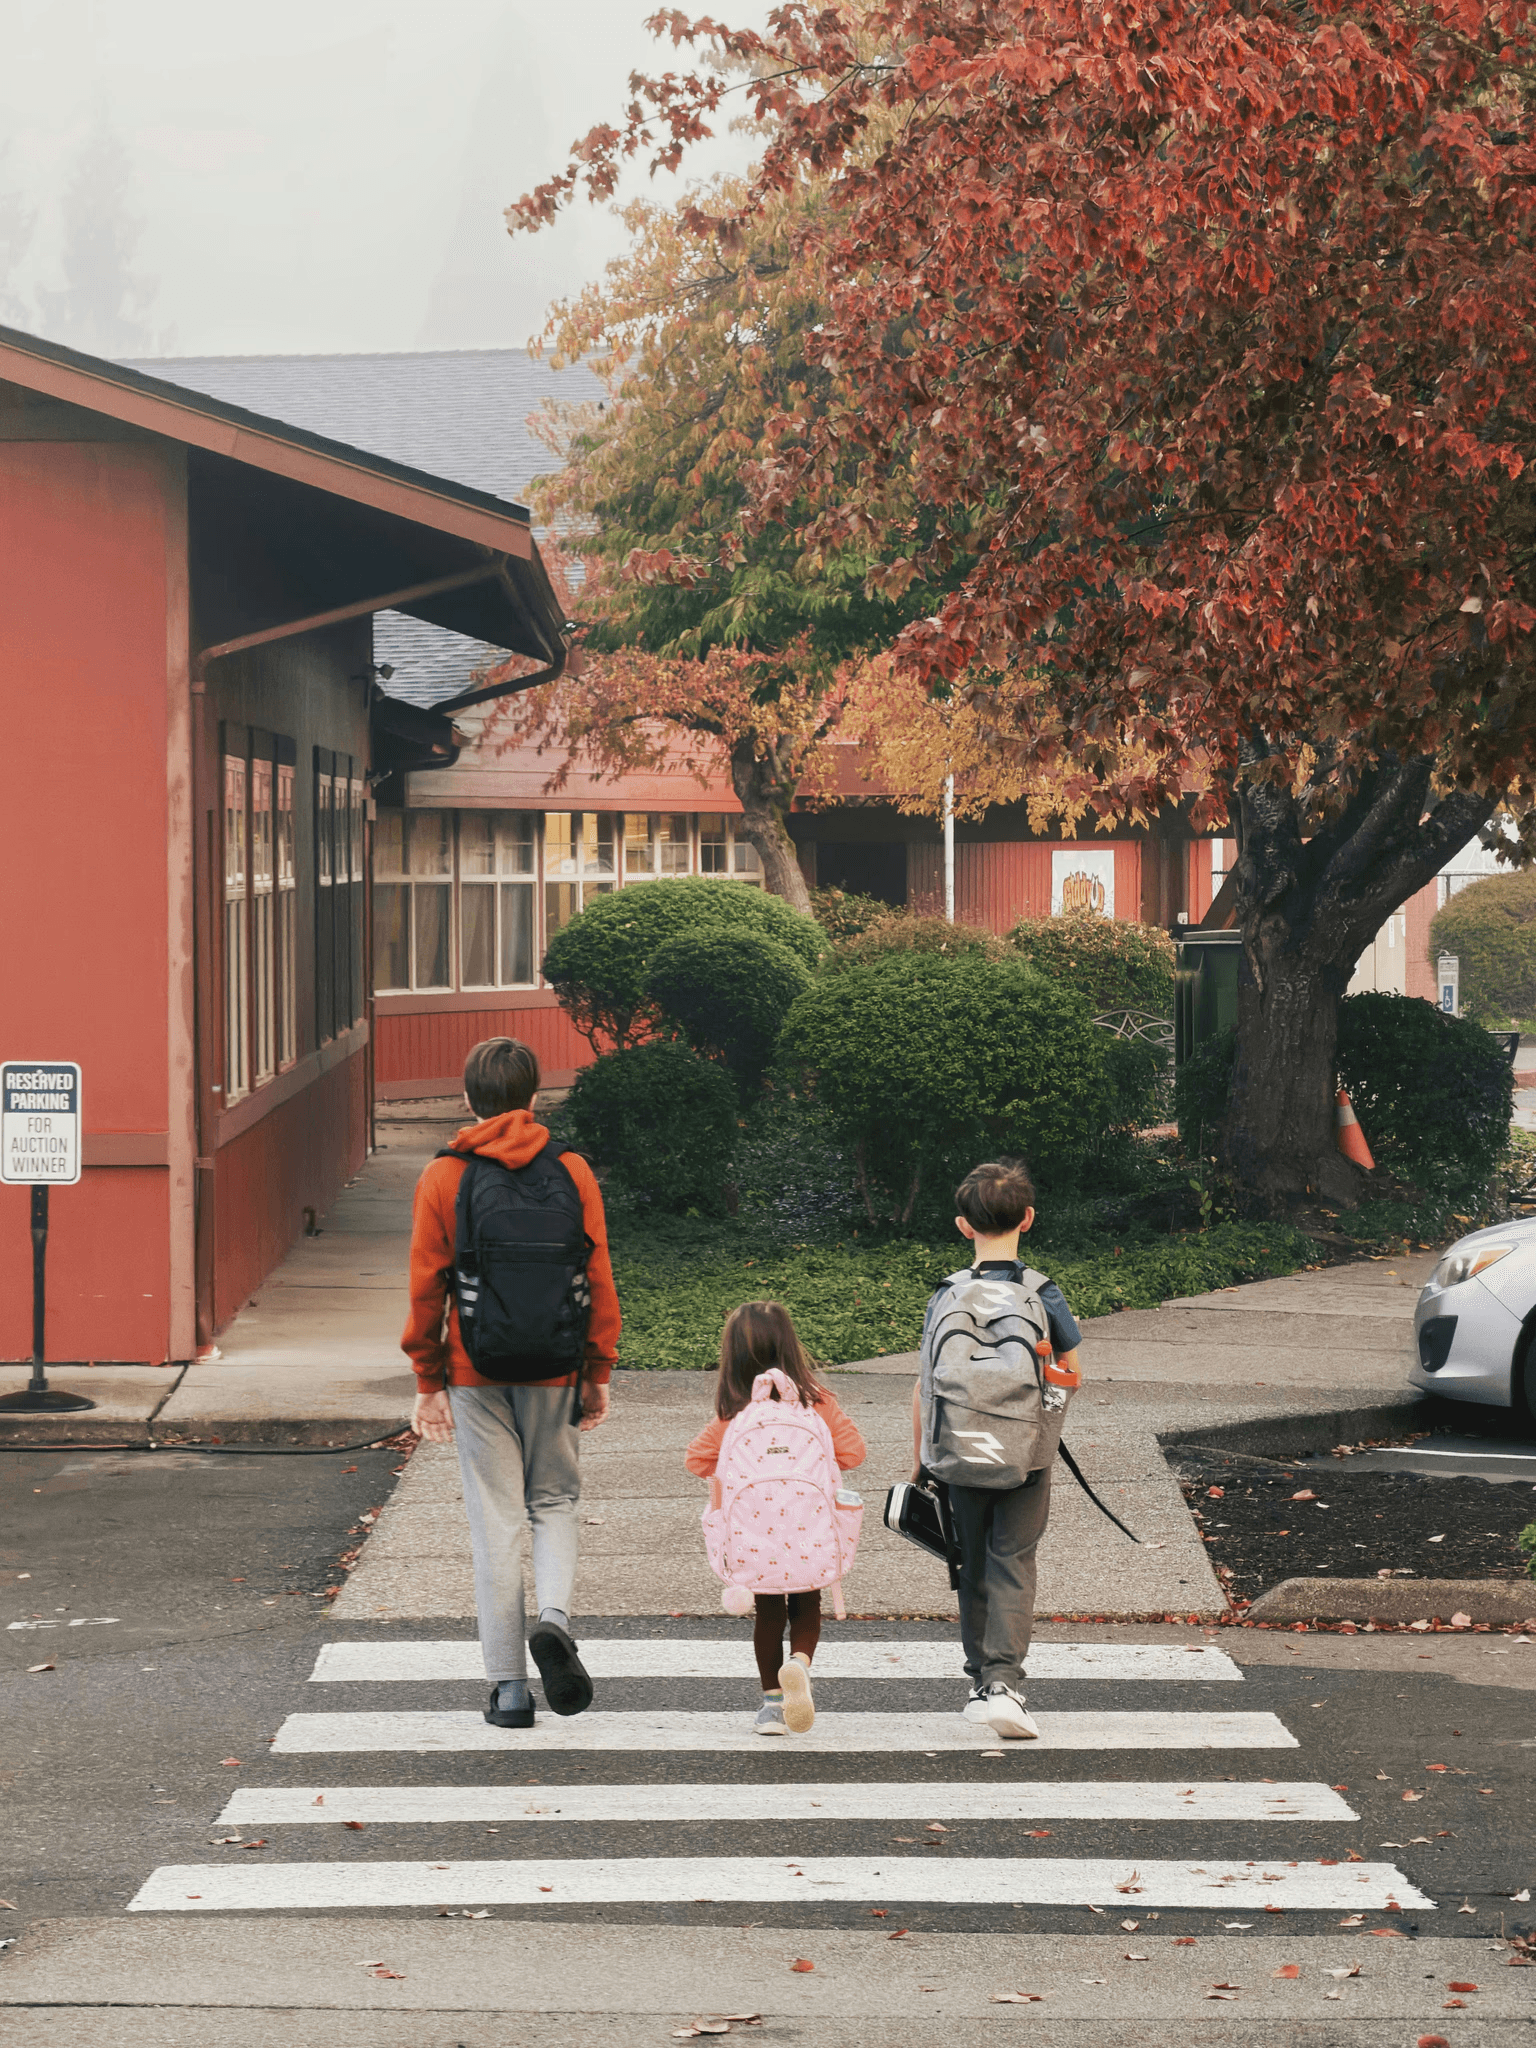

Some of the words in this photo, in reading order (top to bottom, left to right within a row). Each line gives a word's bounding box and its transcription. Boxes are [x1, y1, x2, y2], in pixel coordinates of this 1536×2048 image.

[6, 1073, 74, 1090] RESERVED
[10, 1093, 70, 1110] PARKING
[27, 1117, 52, 1133] FOR
[11, 1137, 68, 1153] AUCTION
[12, 1157, 67, 1173] WINNER
